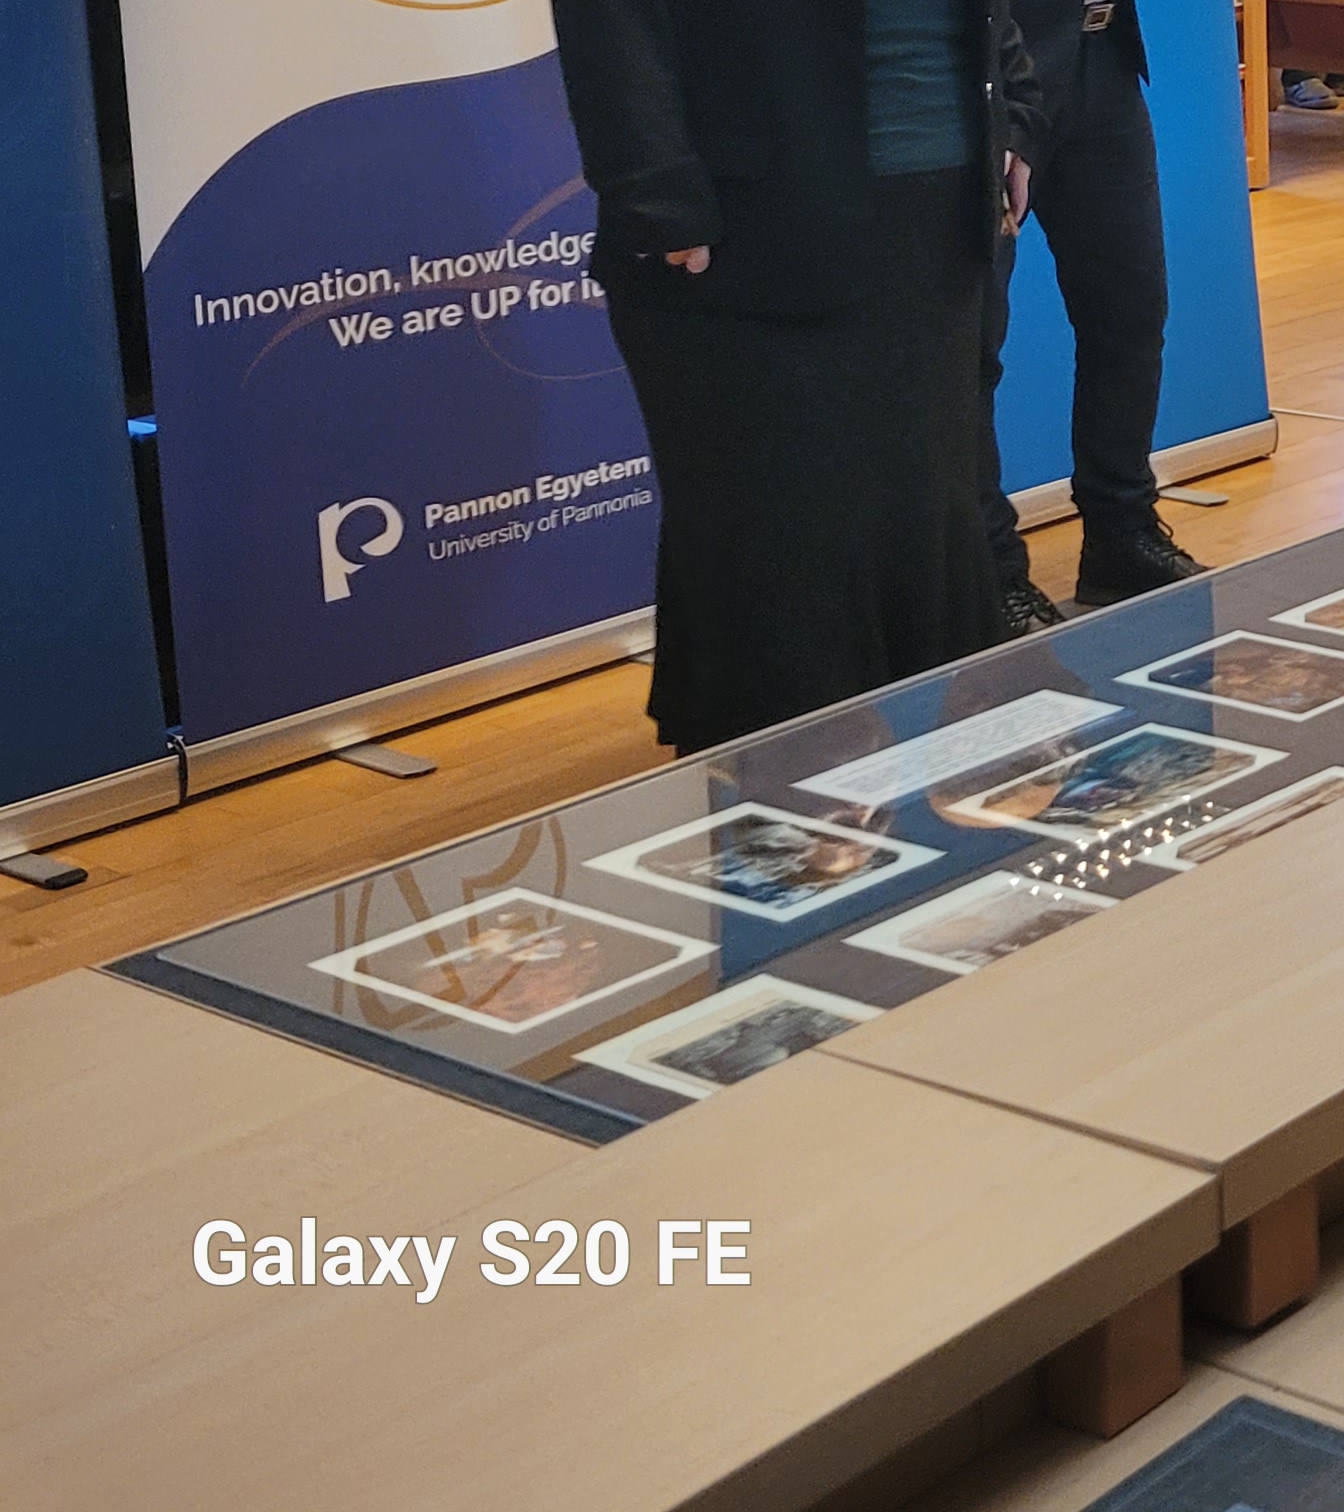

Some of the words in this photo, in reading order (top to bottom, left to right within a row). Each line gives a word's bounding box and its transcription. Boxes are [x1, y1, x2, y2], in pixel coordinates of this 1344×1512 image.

[194, 267, 402, 328] Innovation,
[329, 311, 394, 347] We
[402, 302, 464, 336] are
[471, 285, 522, 320] UP
[526, 278, 576, 311] for
[424, 486, 531, 529] Pannon
[535, 454, 652, 502] Egyetem
[428, 519, 534, 561] University
[537, 509, 562, 532] of
[562, 487, 653, 527] Pannonia
